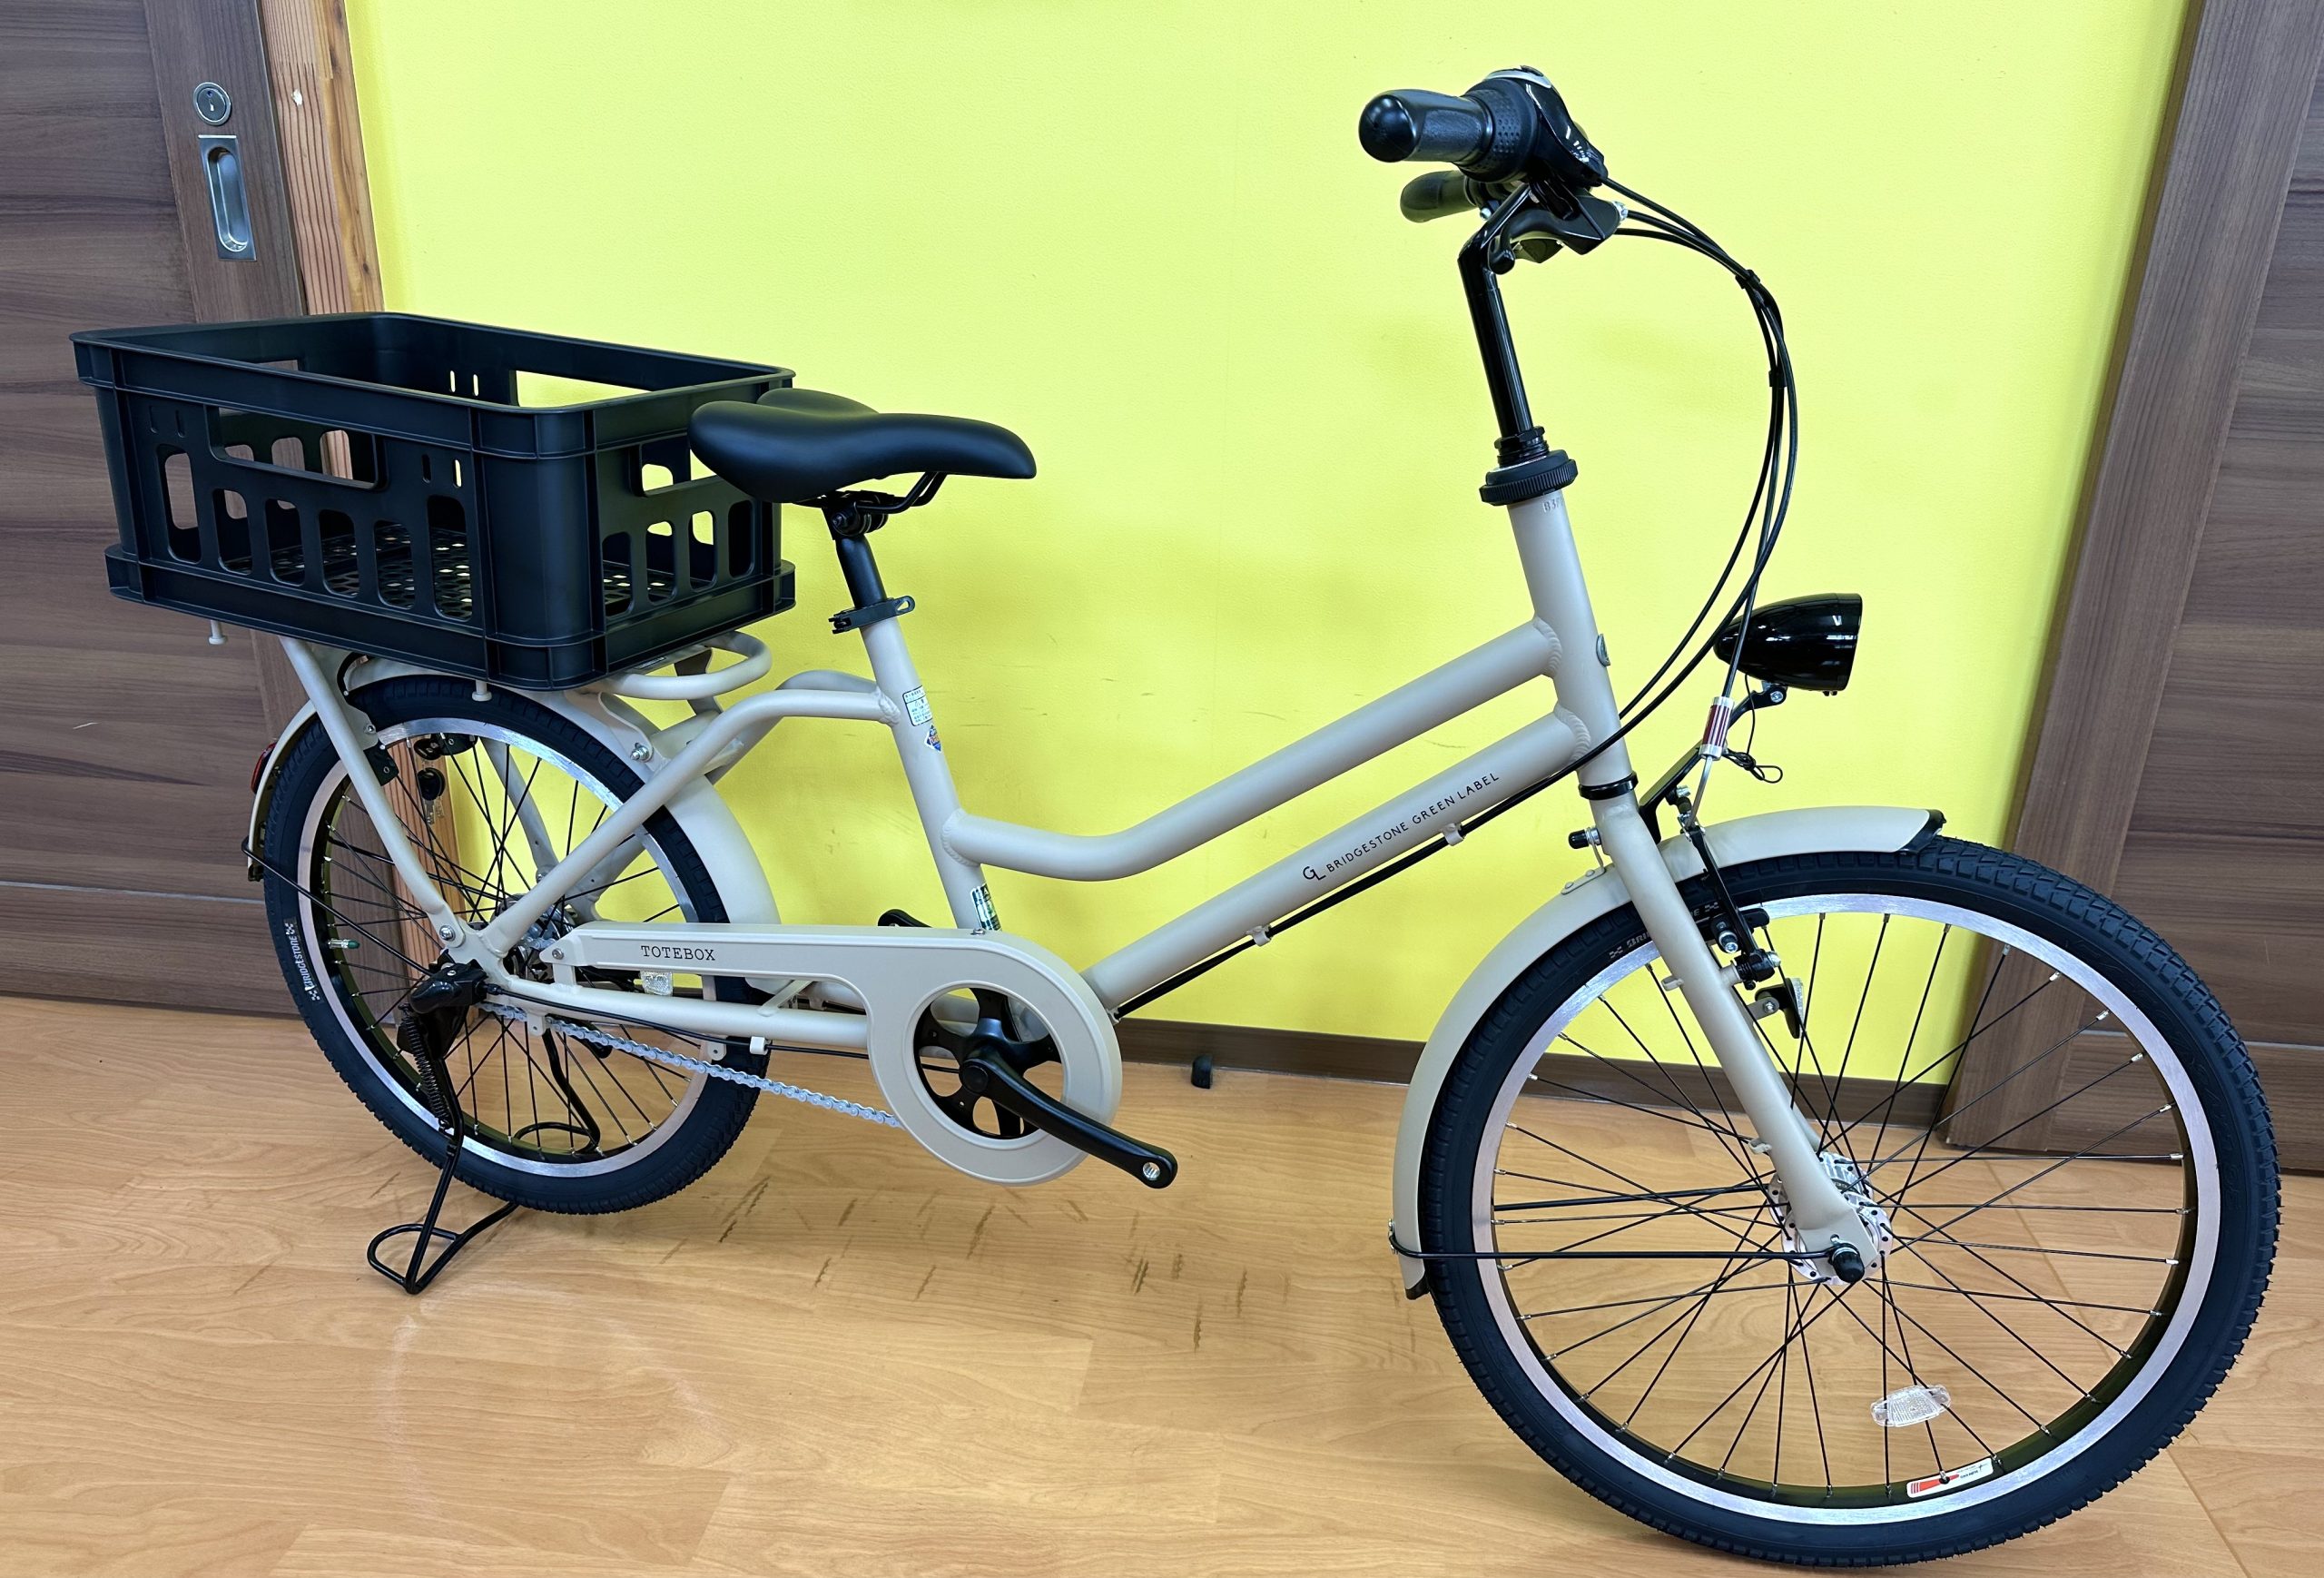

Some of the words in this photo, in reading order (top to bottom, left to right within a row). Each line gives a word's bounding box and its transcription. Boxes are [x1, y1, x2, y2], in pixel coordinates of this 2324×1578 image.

[1325, 822, 1409, 873] BRIDGESTONE
[1412, 795, 1455, 824] GREEN
[1457, 773, 1499, 800] LABEL
[290, 935, 315, 991] BRIDGESTONE
[640, 945, 715, 961] TOTEBOX
